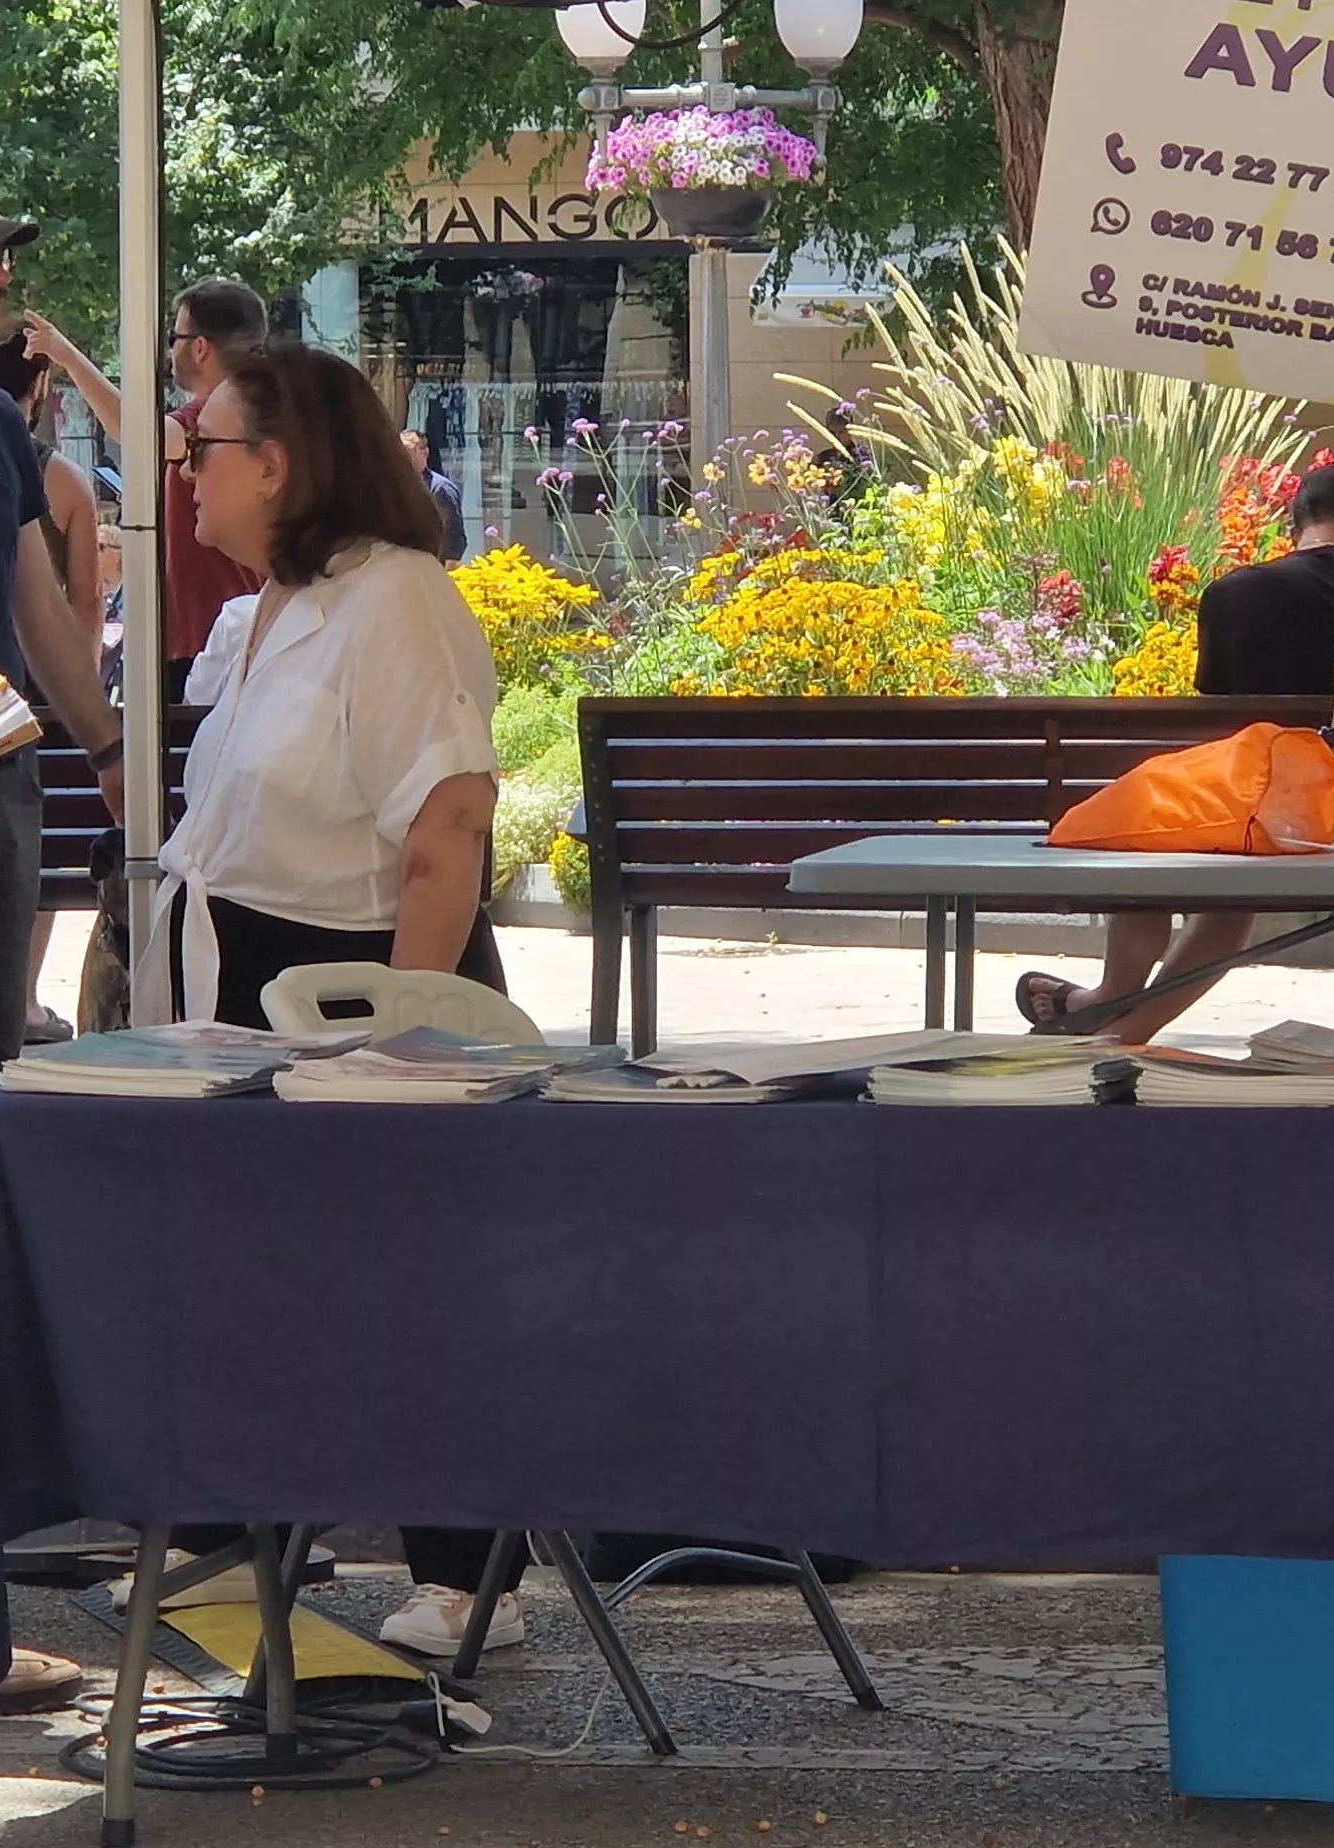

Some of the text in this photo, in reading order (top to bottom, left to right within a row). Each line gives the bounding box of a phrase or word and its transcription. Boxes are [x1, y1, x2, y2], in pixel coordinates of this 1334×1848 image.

[1160, 143, 1224, 176] 974
[1232, 155, 1277, 185] 22
[1287, 162, 1330, 192] 77
[1151, 210, 1214, 242] 620
[1225, 221, 1263, 251] 71
[1276, 229, 1319, 259] 56
[1142, 273, 1169, 292] C/
[1172, 277, 1261, 308] RAMÓN
[1266, 294, 1287, 313] J.
[1136, 316, 1234, 349] HUESCA
[1166, 299, 1303, 337] POSTERIOR
